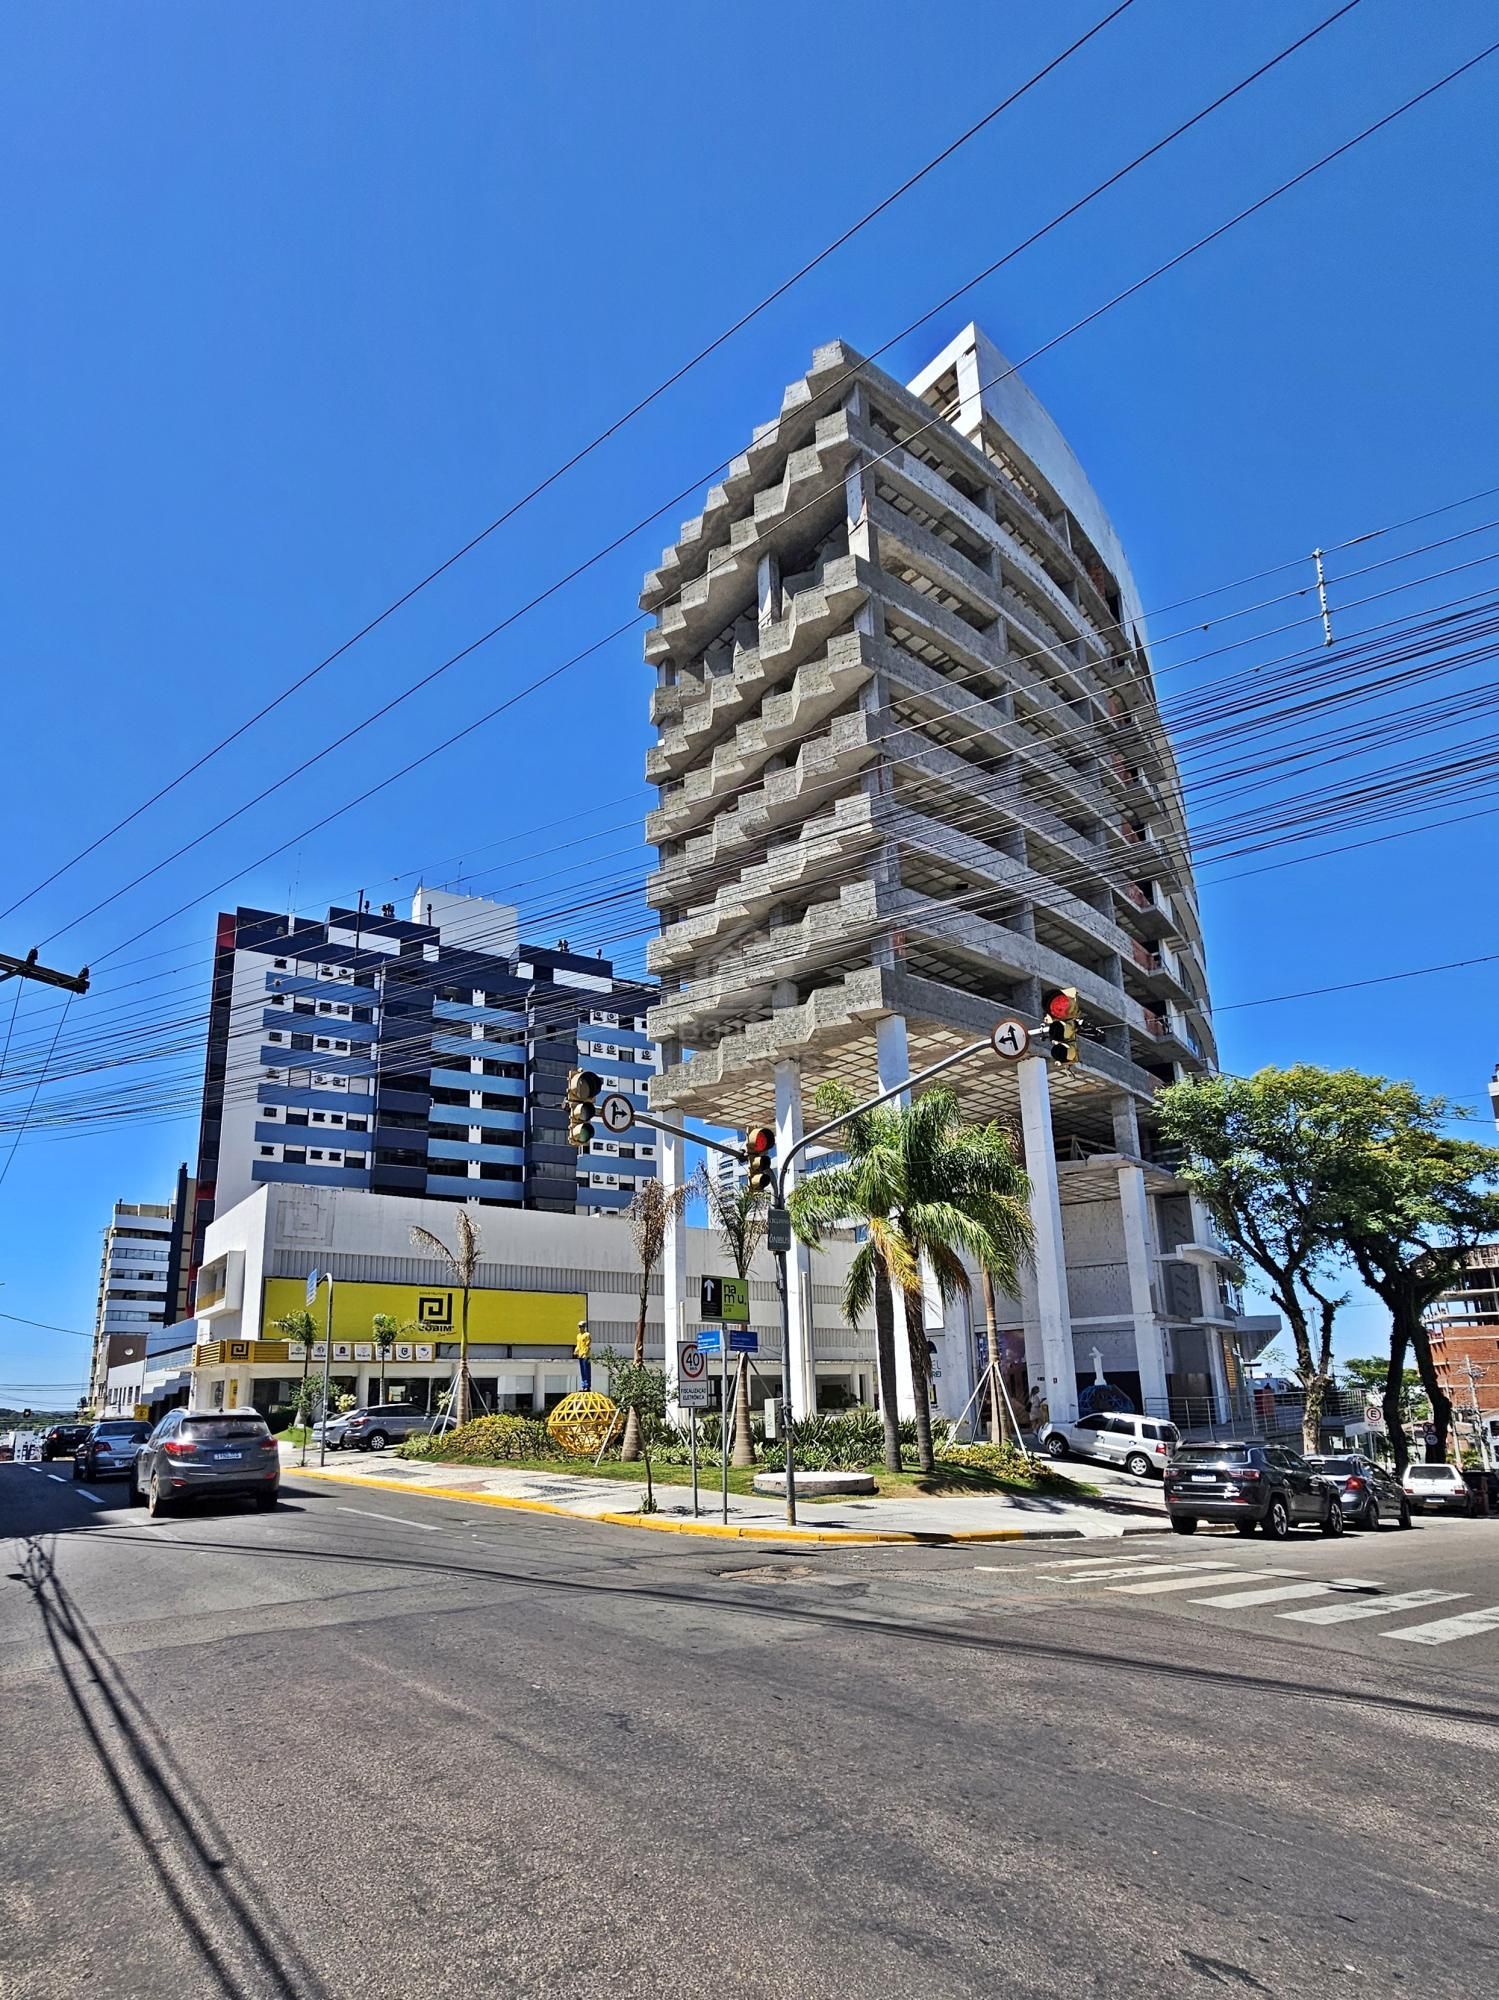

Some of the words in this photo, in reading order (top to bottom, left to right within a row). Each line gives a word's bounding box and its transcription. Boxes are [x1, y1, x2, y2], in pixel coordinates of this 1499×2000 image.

[686, 1353, 700, 1366] 40
[681, 1386, 707, 1394] FISCALIZAÇÃO
[682, 1393, 705, 1401] ELETRÔNICA
[1370, 1410, 1377, 1418] E
